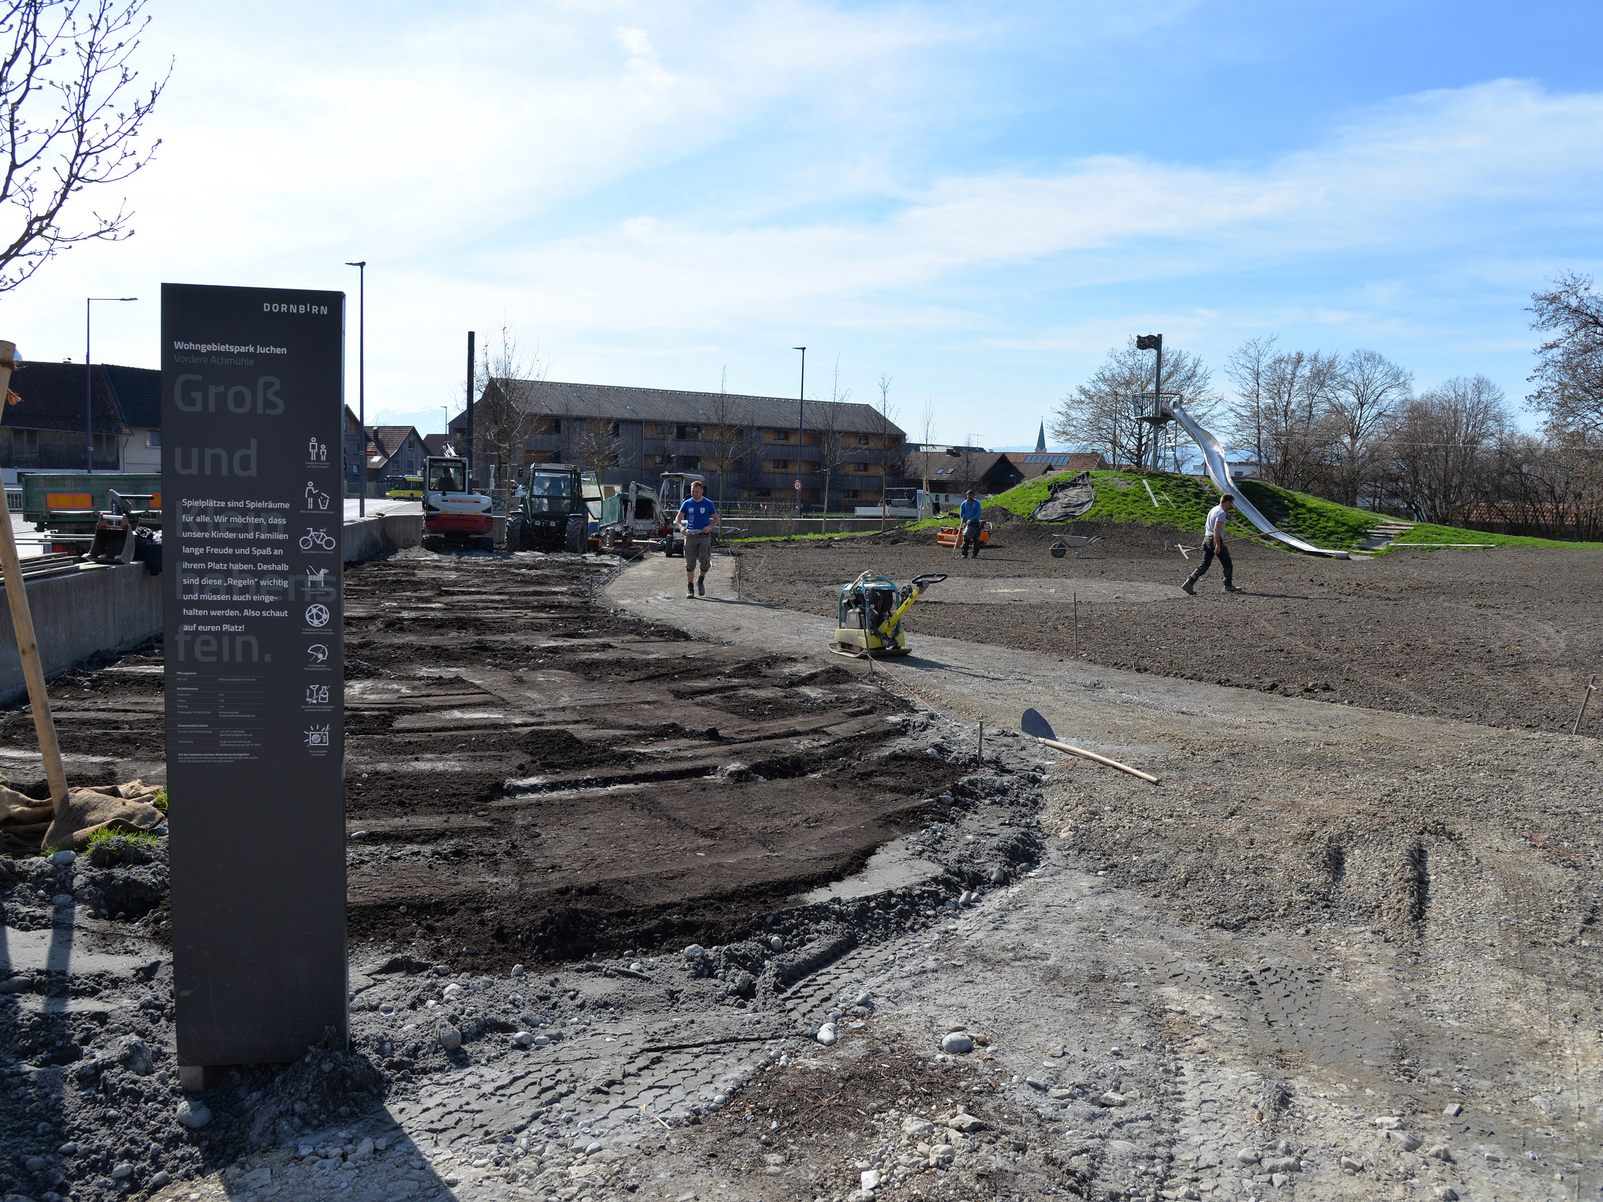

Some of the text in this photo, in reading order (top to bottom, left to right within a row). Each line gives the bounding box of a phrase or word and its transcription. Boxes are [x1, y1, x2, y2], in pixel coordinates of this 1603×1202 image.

[264, 303, 328, 315] DORNBIRN
[174, 341, 287, 354] Wohngebietspark Juchen
[174, 355, 208, 364] Vordere
[174, 374, 285, 415] Groß
[175, 438, 257, 477] und
[182, 499, 290, 510] Spielplätze sind Spielräume
[230, 516, 266, 524] möchten,
[255, 532, 288, 540] Familien
[182, 546, 204, 555] lange
[251, 548, 271, 556] Spaß
[208, 562, 228, 570] Platz
[229, 562, 255, 570] haben.
[258, 563, 288, 571] Deshalb
[260, 579, 288, 588] wichtig
[253, 595, 277, 603] einge-
[262, 609, 288, 617] schaut
[222, 624, 244, 632] Platz!
[175, 624, 272, 662] fein.
